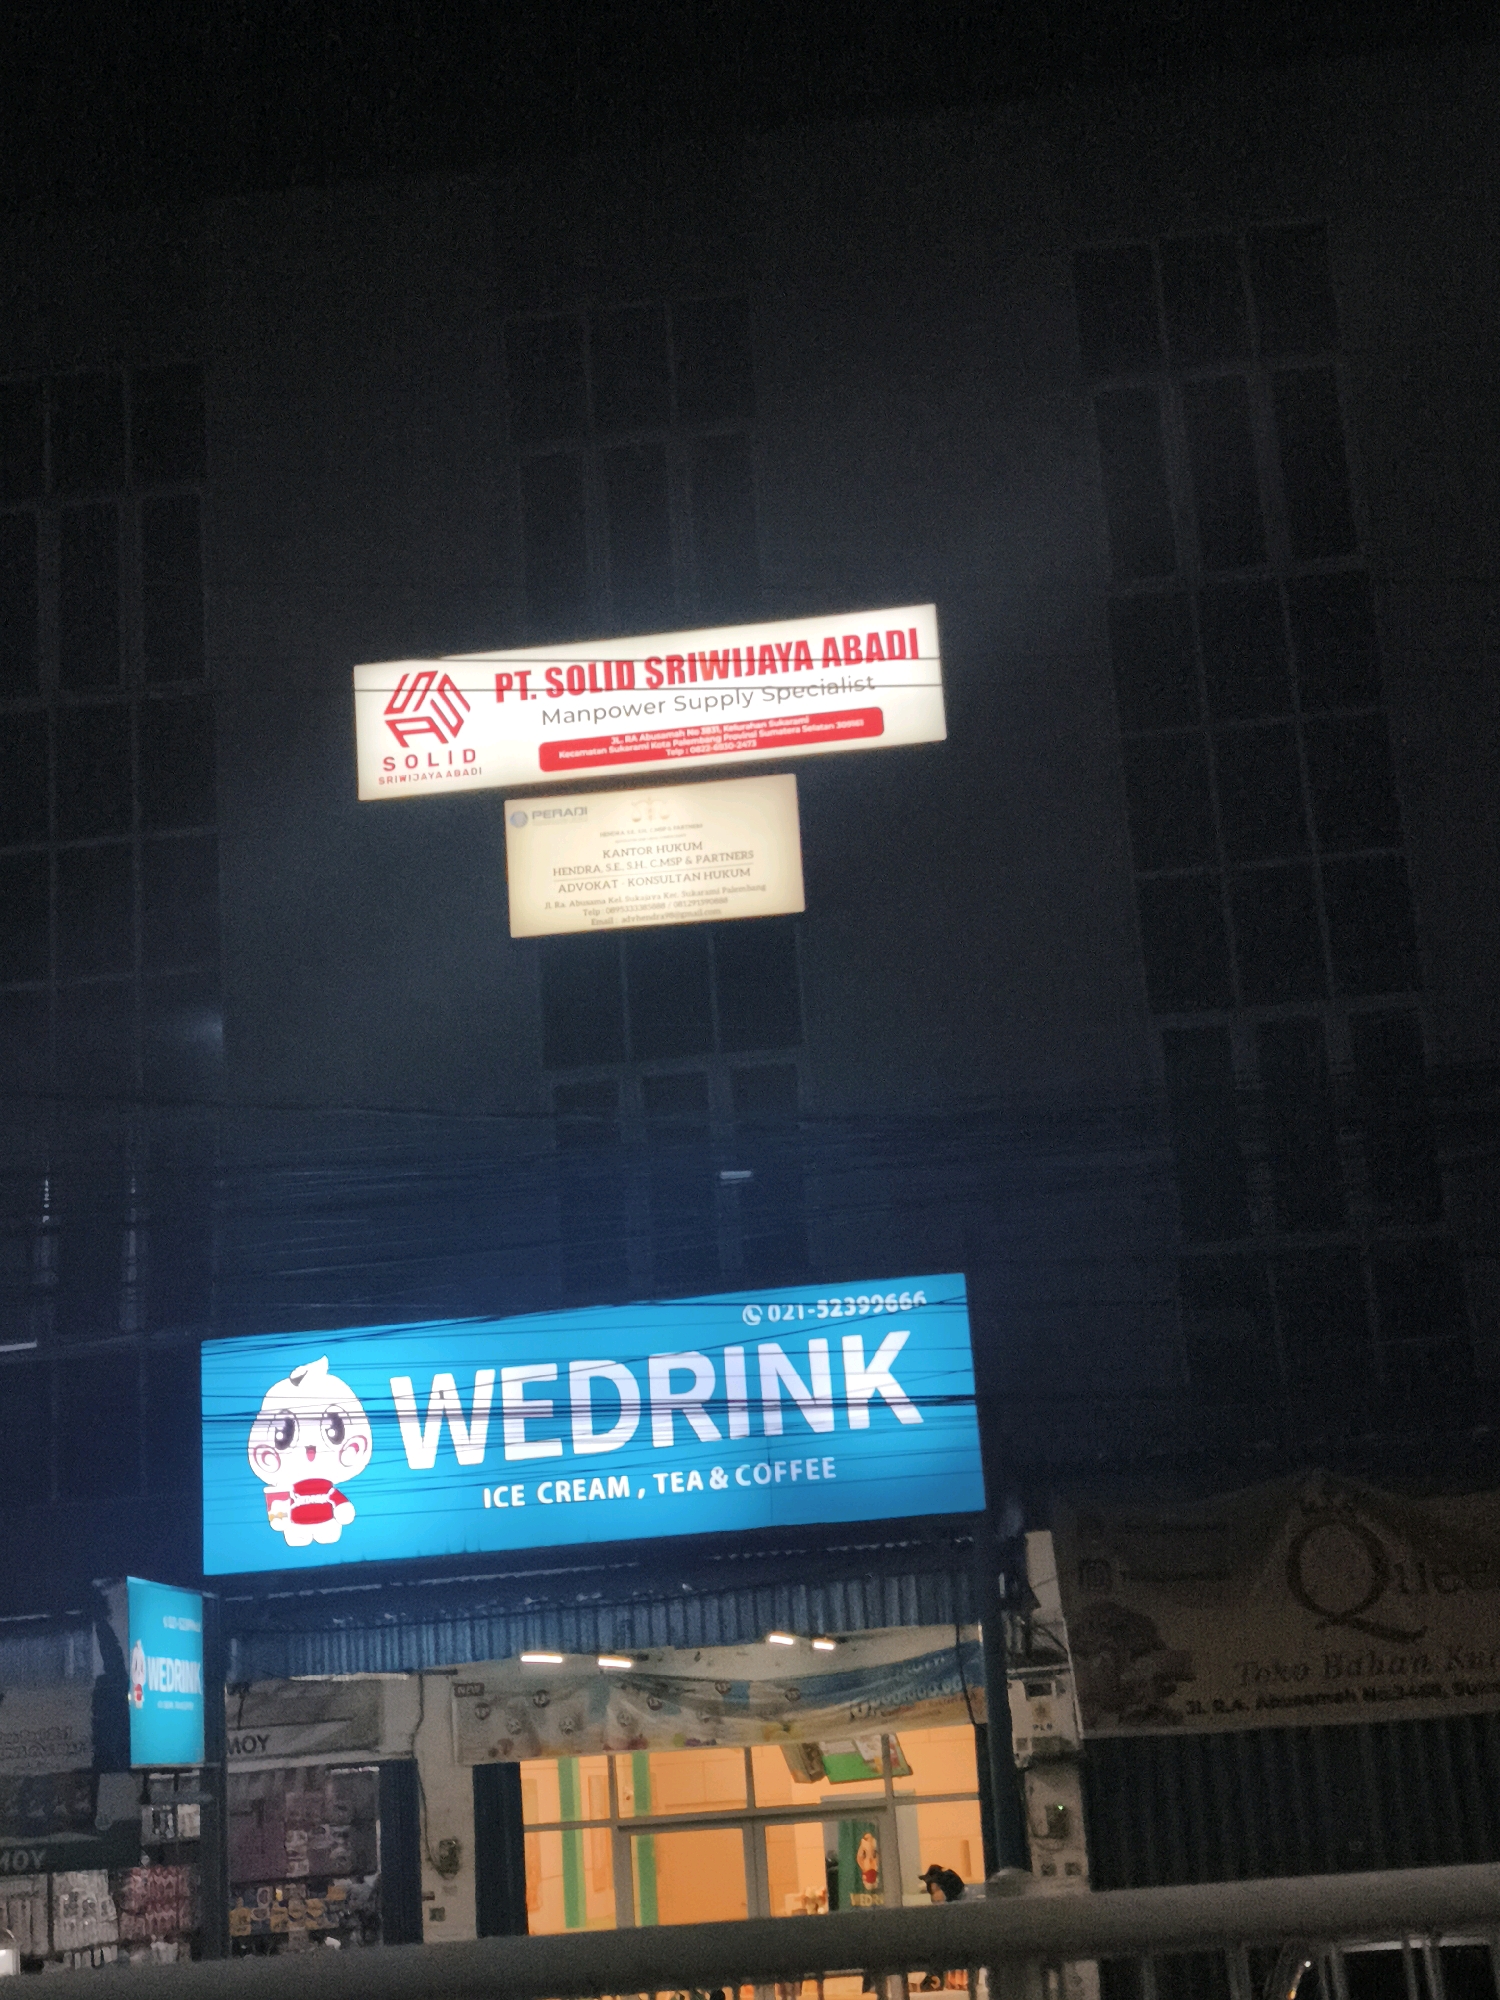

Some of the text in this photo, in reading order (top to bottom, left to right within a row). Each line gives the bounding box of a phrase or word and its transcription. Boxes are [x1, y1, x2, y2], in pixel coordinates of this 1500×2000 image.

[495, 628, 919, 703] PT. SOLID SRIWIJAYA ABADI
[541, 675, 876, 726] Manpower Supply Specialist
[383, 748, 477, 772] SOLID
[378, 766, 482, 785] SRIWIJAYA ABADI
[532, 805, 588, 820] PERADI
[602, 841, 703, 859] KANTOR HUKUM
[685, 855, 693, 866] &
[696, 850, 754, 864] PARTNERS
[558, 879, 619, 894] ADVOKAT
[627, 872, 701, 888] KONSULTAN
[704, 867, 751, 881] HUKUM
[767, 1289, 928, 1322] 021-52399666
[389, 1330, 924, 1471] WEDRINK
[483, 1484, 526, 1510] ICE
[735, 1456, 837, 1488] COFFEE
[147, 1655, 203, 1695] WEDRINK
